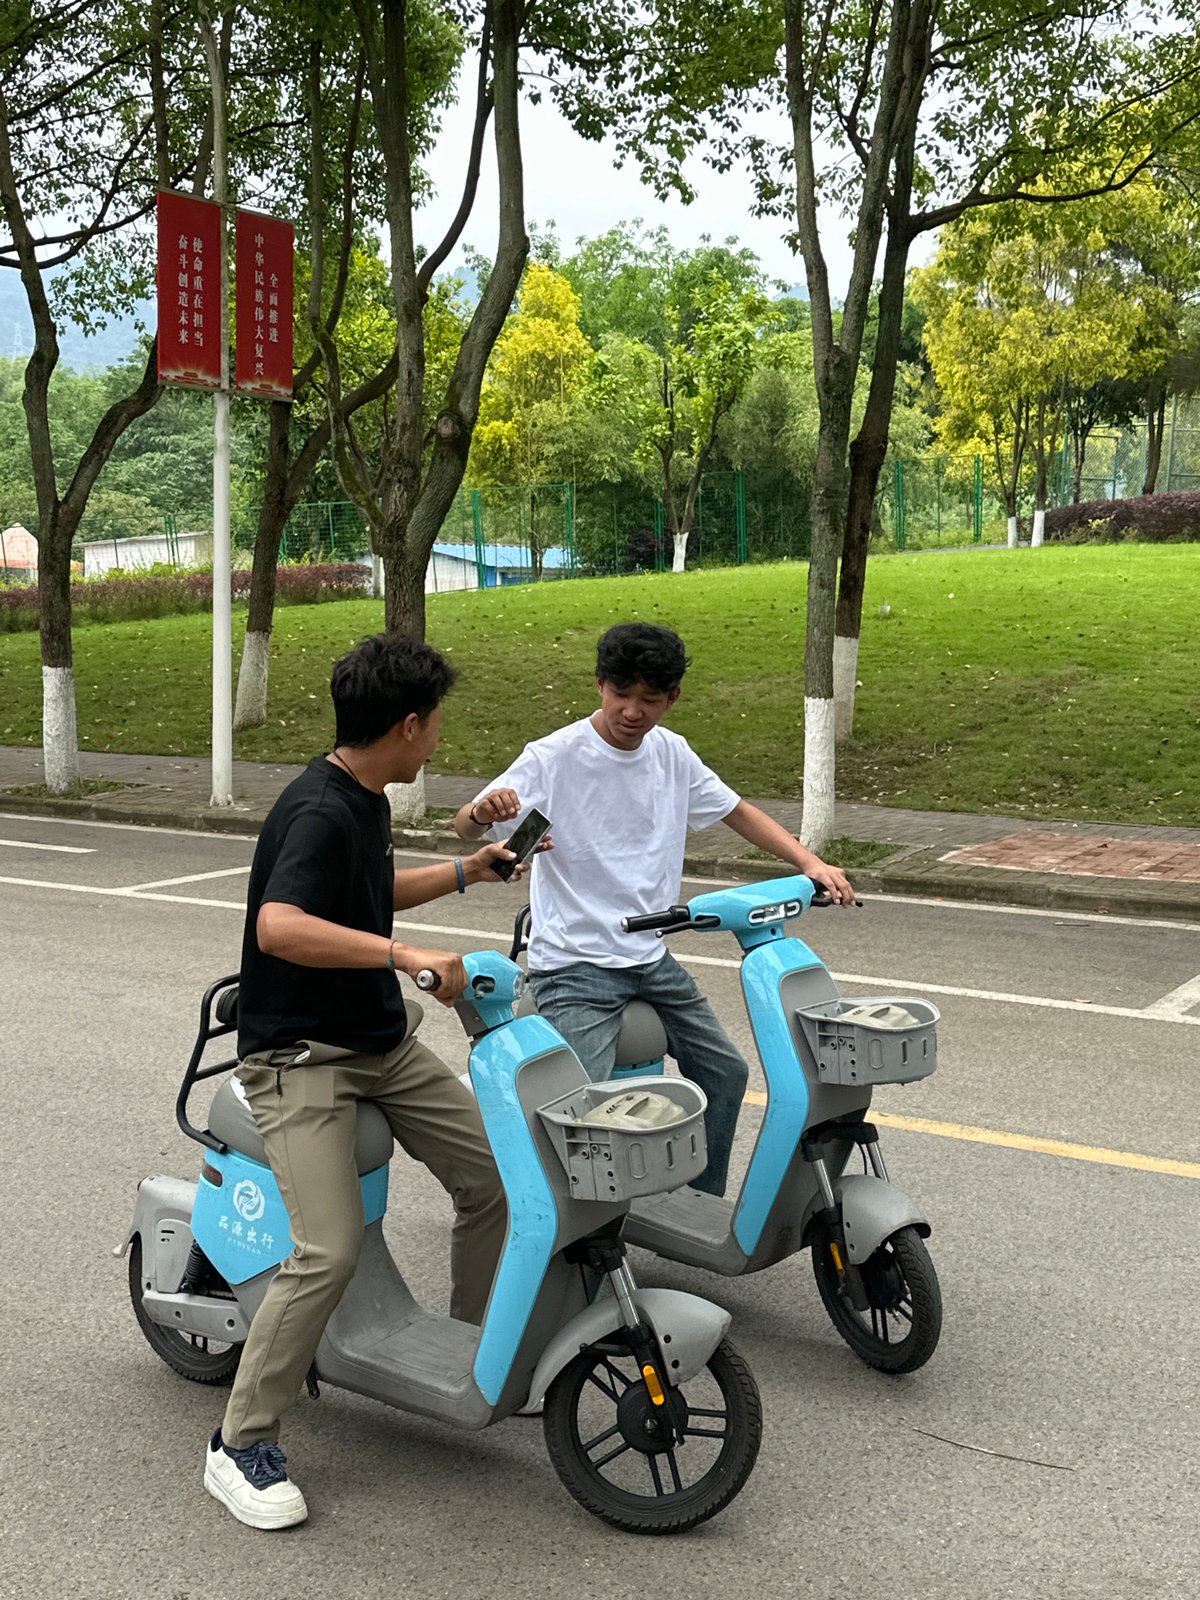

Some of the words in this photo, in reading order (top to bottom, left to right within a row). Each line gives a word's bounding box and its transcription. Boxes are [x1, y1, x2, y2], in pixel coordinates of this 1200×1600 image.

[178, 234, 188, 344] 奋斗创造未来
[193, 237, 203, 347] 使命重在担当
[255, 233, 264, 375] 中华民族伟大复兴
[269, 273, 278, 343] 全面推进
[219, 1215, 274, 1249] 品源出行
